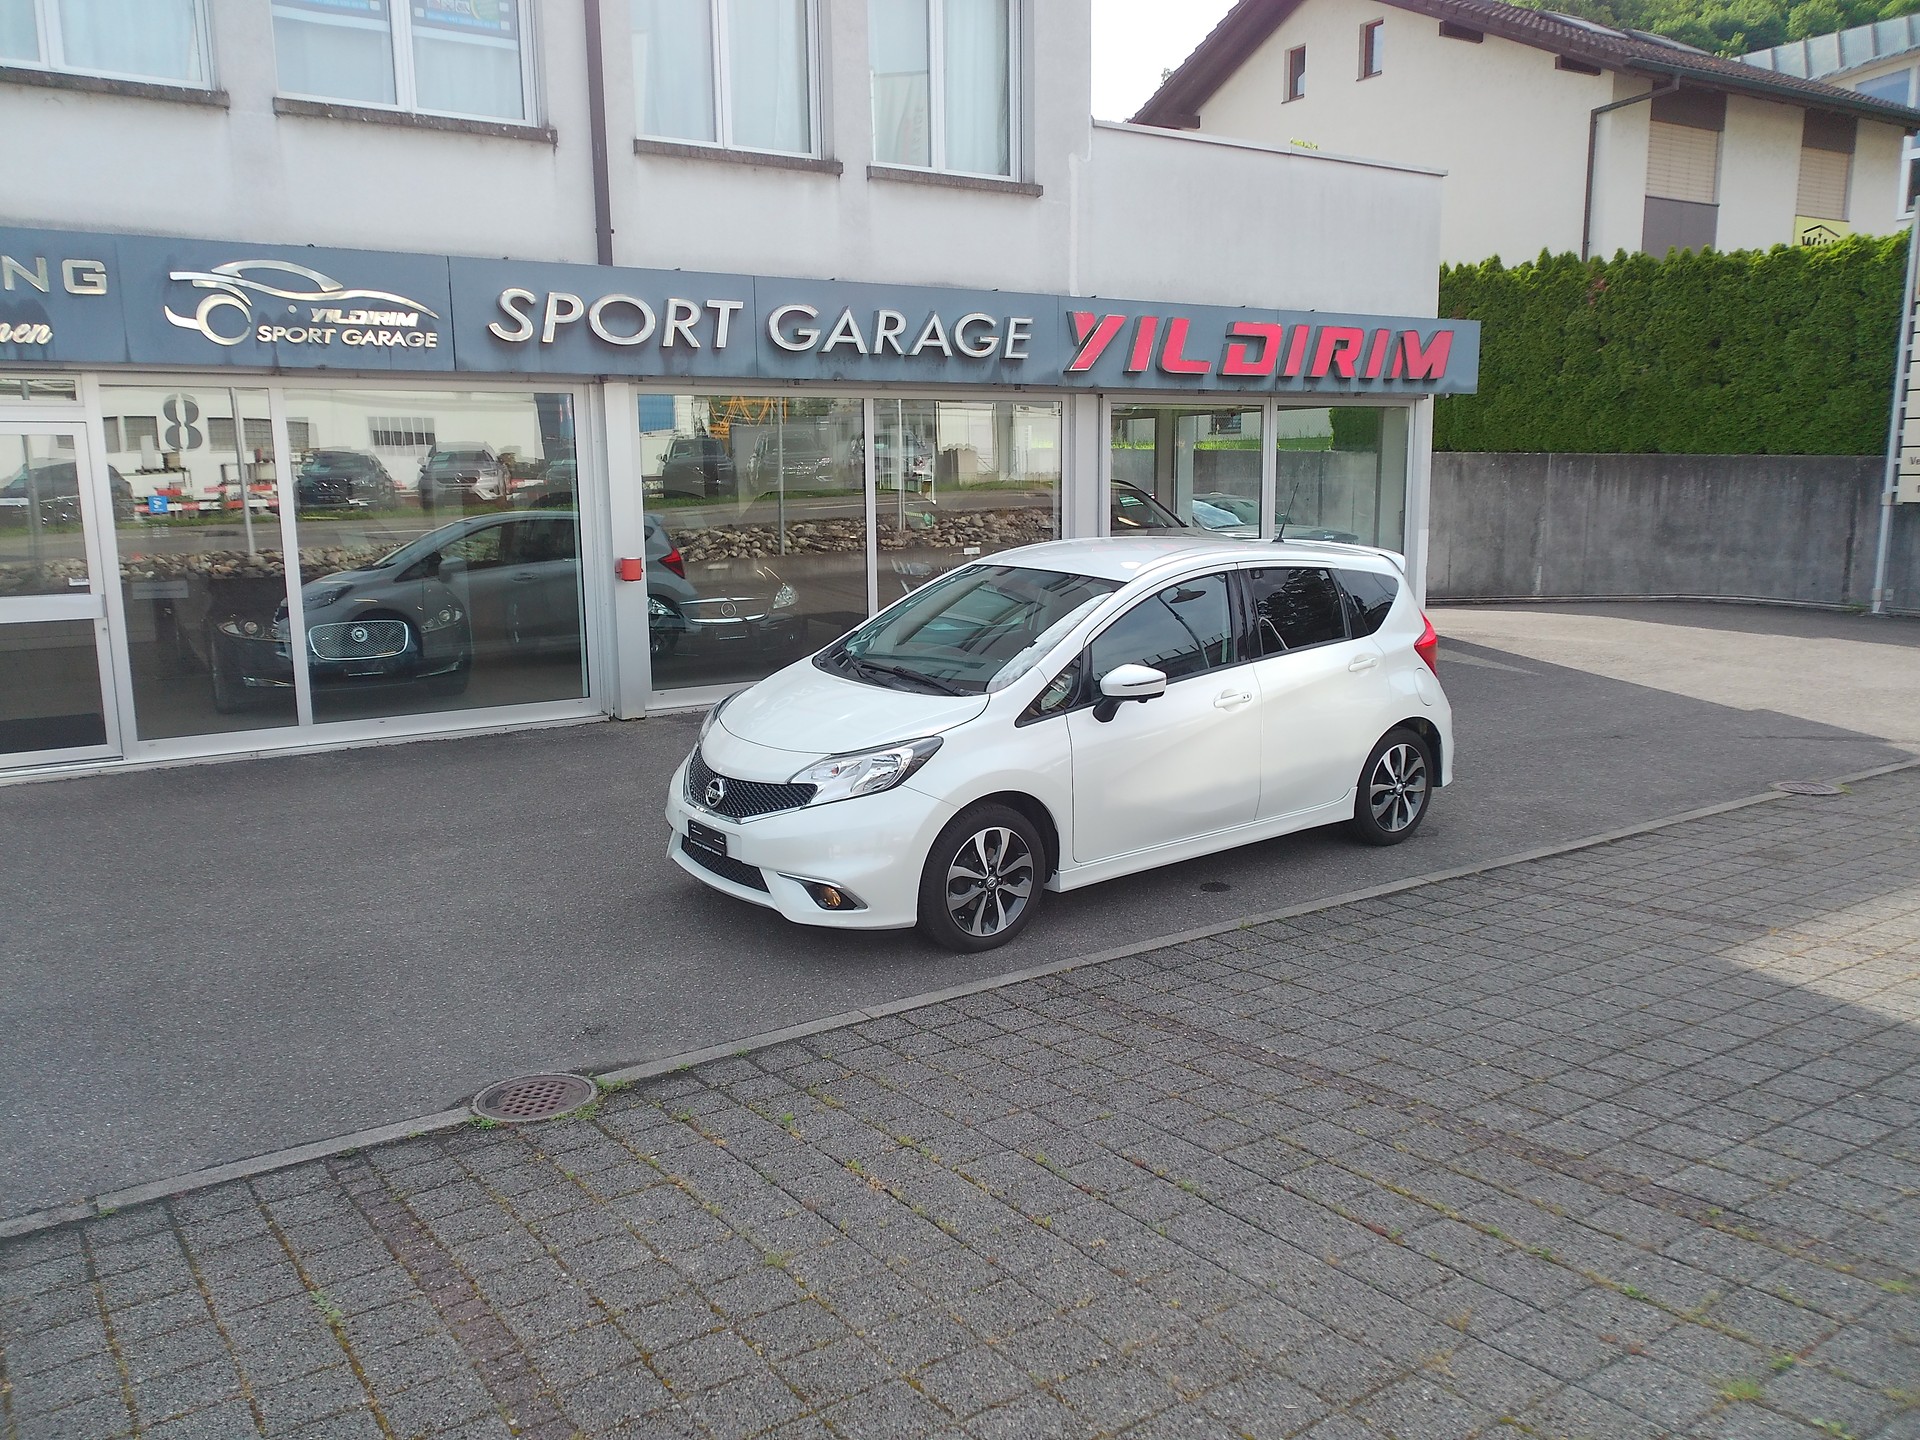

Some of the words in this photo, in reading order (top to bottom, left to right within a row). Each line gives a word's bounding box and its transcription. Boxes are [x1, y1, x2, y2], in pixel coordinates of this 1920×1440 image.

[309, 307, 419, 328] YILDIRIM
[256, 324, 337, 344] SPORT
[341, 329, 438, 348] GARAGE
[488, 287, 744, 349] SPORT
[767, 304, 1034, 360] GARAGE
[1063, 310, 1454, 381] YILDIRIM
